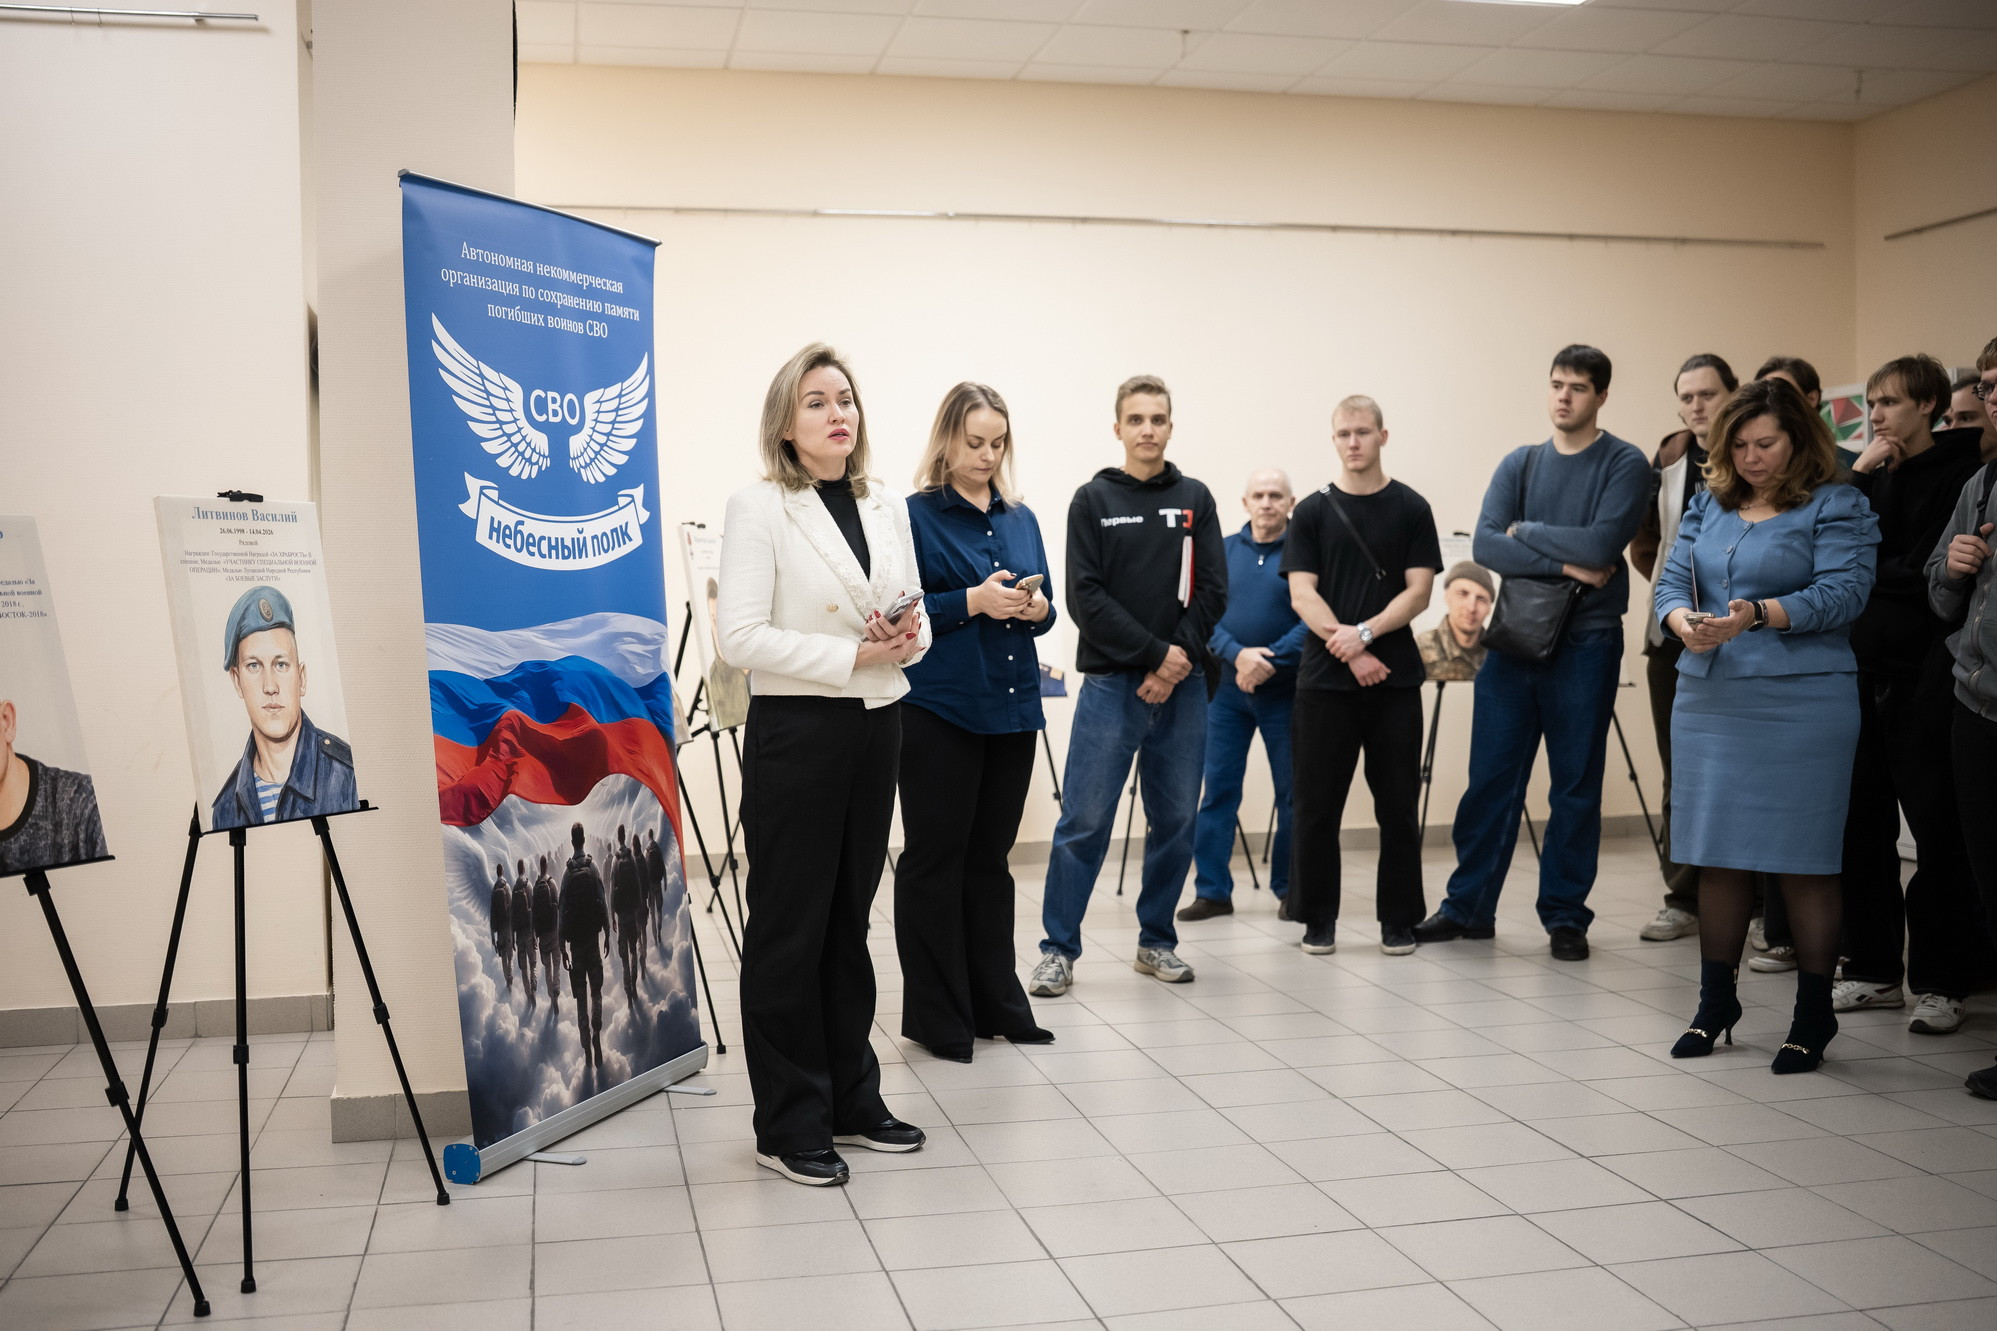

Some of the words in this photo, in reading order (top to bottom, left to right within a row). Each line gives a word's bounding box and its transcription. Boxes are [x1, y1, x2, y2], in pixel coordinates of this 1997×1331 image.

[461, 241, 534, 273] Автономная
[536, 262, 624, 294] некоммерческая
[441, 268, 520, 296] организация
[522, 285, 536, 299] по
[538, 289, 603, 313] сохранению
[604, 303, 640, 322] памяти
[487, 304, 545, 327] погибших
[547, 315, 584, 334] воинов
[586, 319, 608, 339] СВО
[529, 389, 580, 425] СВО
[192, 506, 249, 521] Литвинов
[251, 509, 298, 523] Василий
[591, 521, 634, 557] полк
